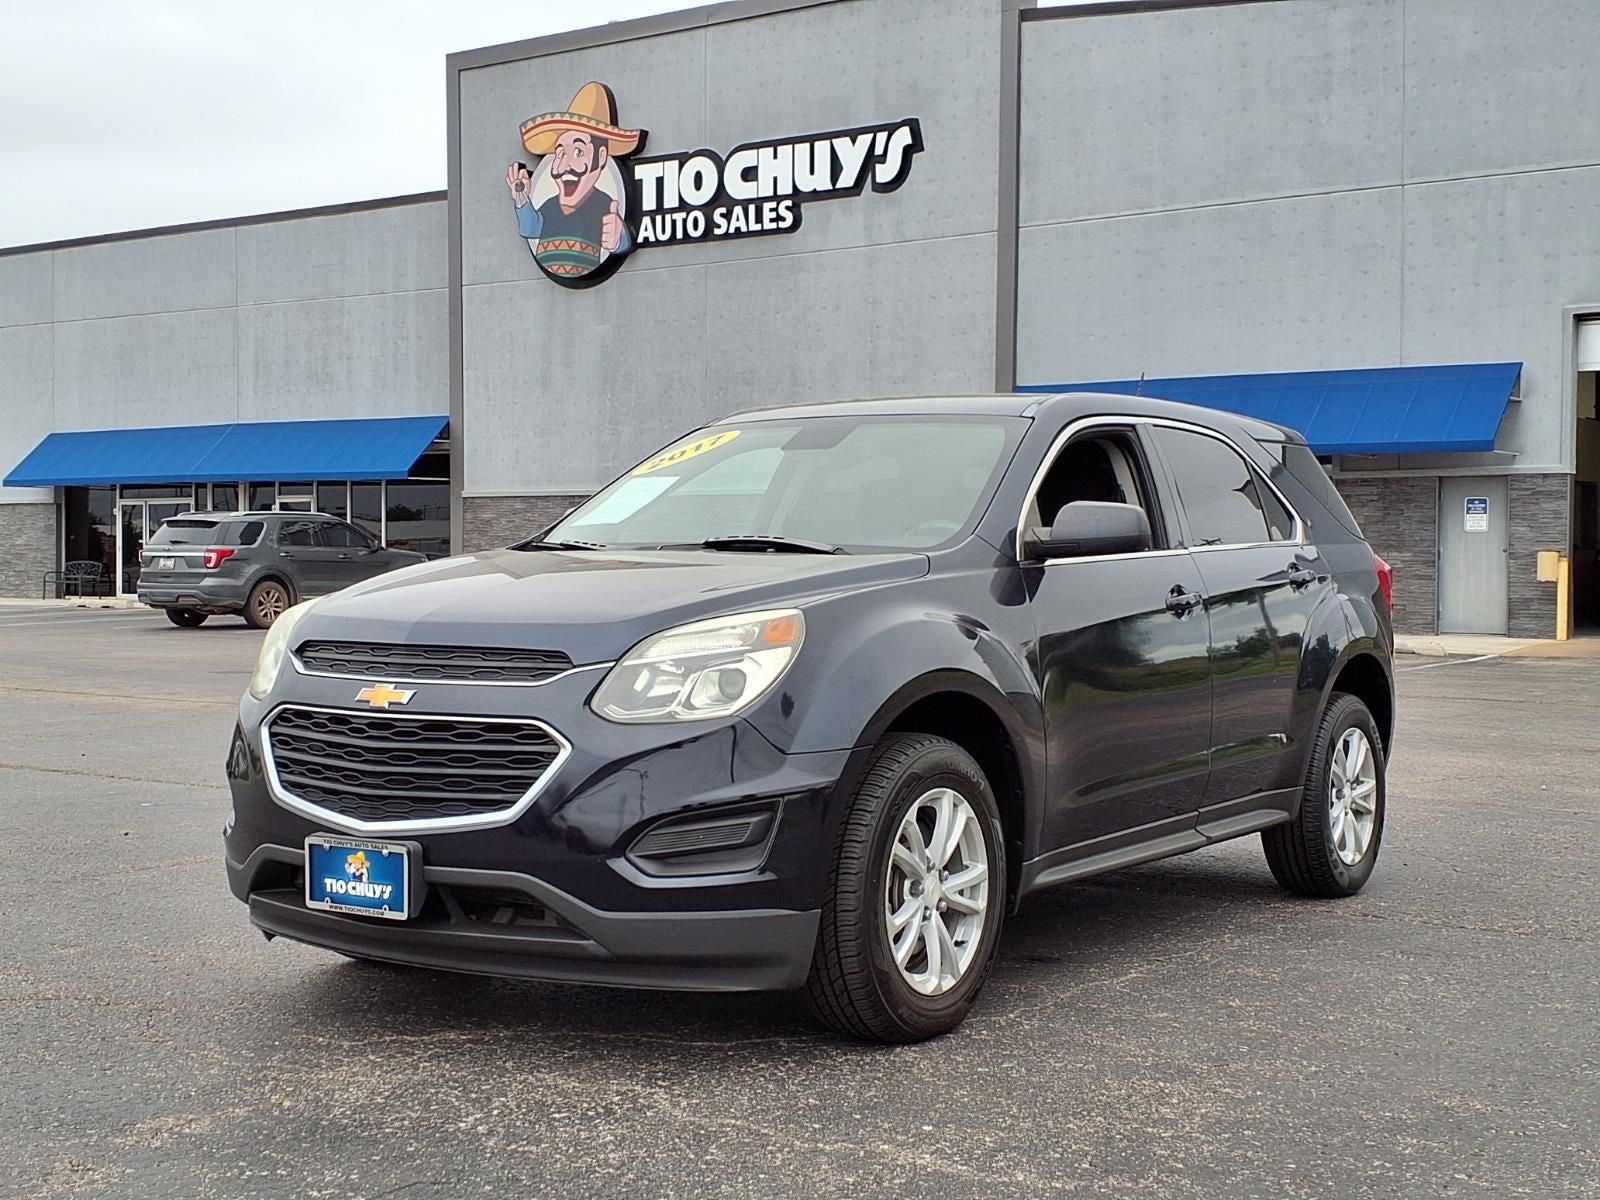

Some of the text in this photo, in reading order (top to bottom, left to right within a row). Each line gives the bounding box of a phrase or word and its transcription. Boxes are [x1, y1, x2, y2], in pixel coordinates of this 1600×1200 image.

[634, 125, 913, 212] TIO CHUY'S
[637, 200, 794, 244] AUTO SALES
[647, 434, 727, 471] 2017
[944, 760, 978, 782] UMHO
[324, 878, 392, 899] TIO CHUY'S
